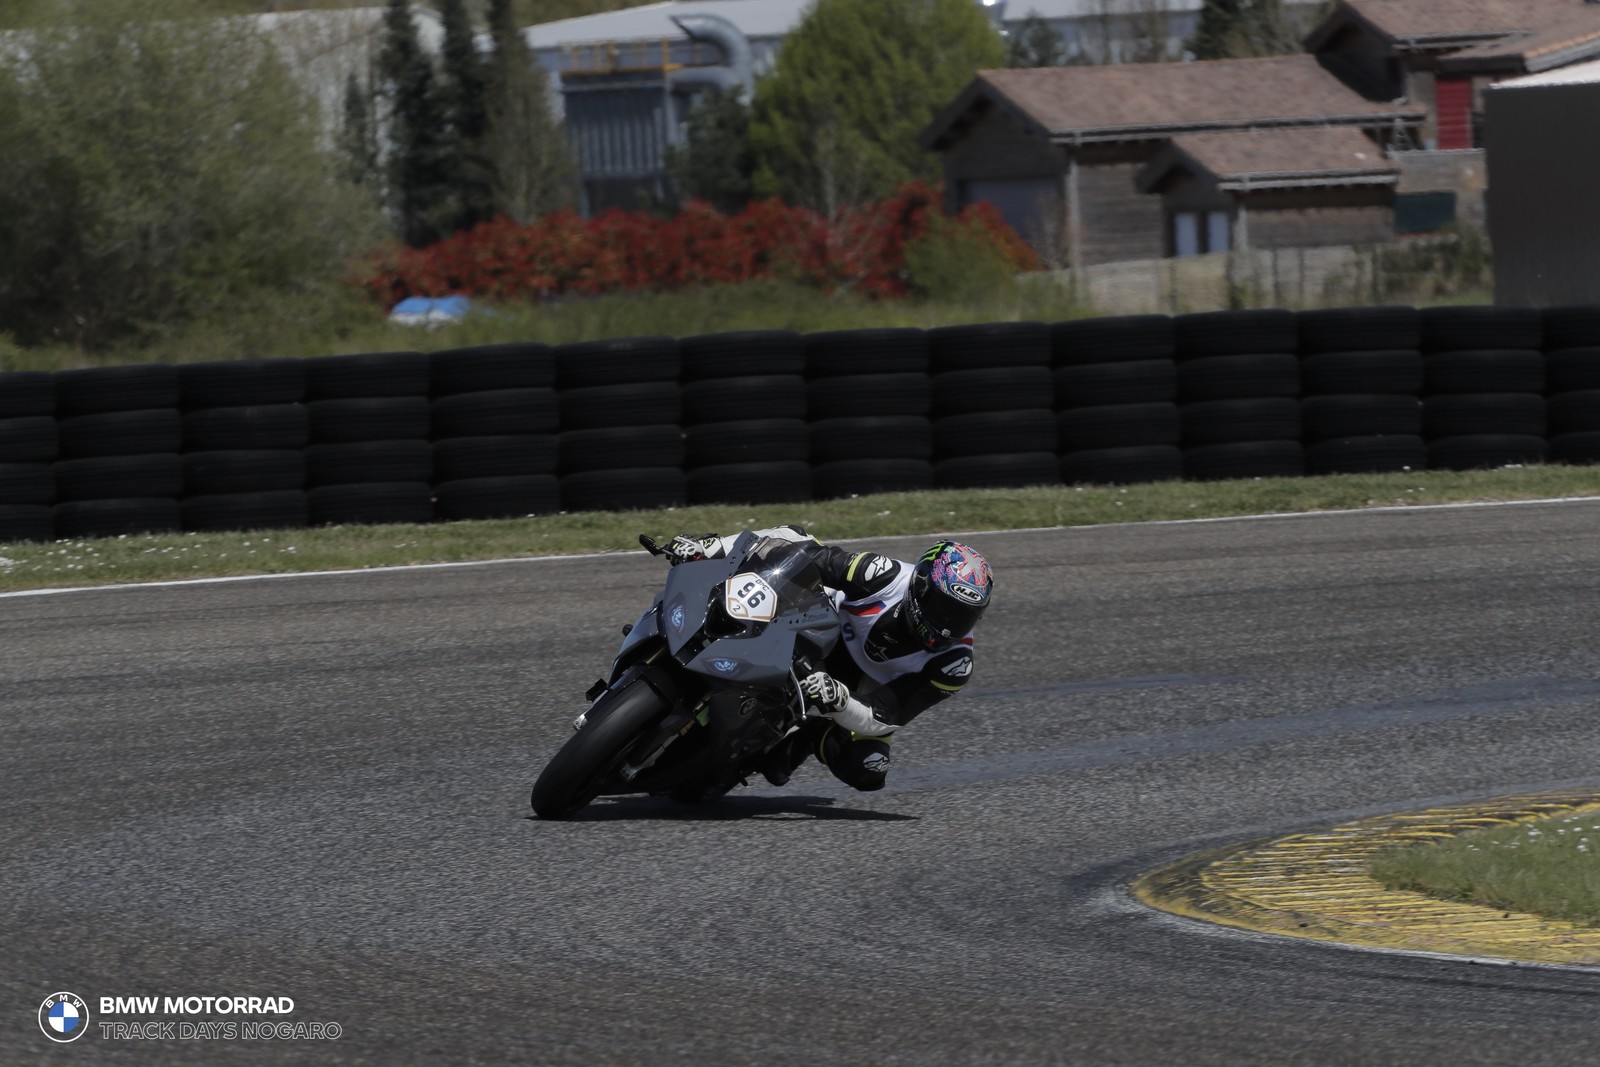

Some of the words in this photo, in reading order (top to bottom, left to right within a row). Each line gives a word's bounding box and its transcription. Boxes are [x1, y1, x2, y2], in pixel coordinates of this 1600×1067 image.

[737, 582, 766, 608] 96
[955, 586, 979, 600] HJC
[732, 604, 741, 613] 2
